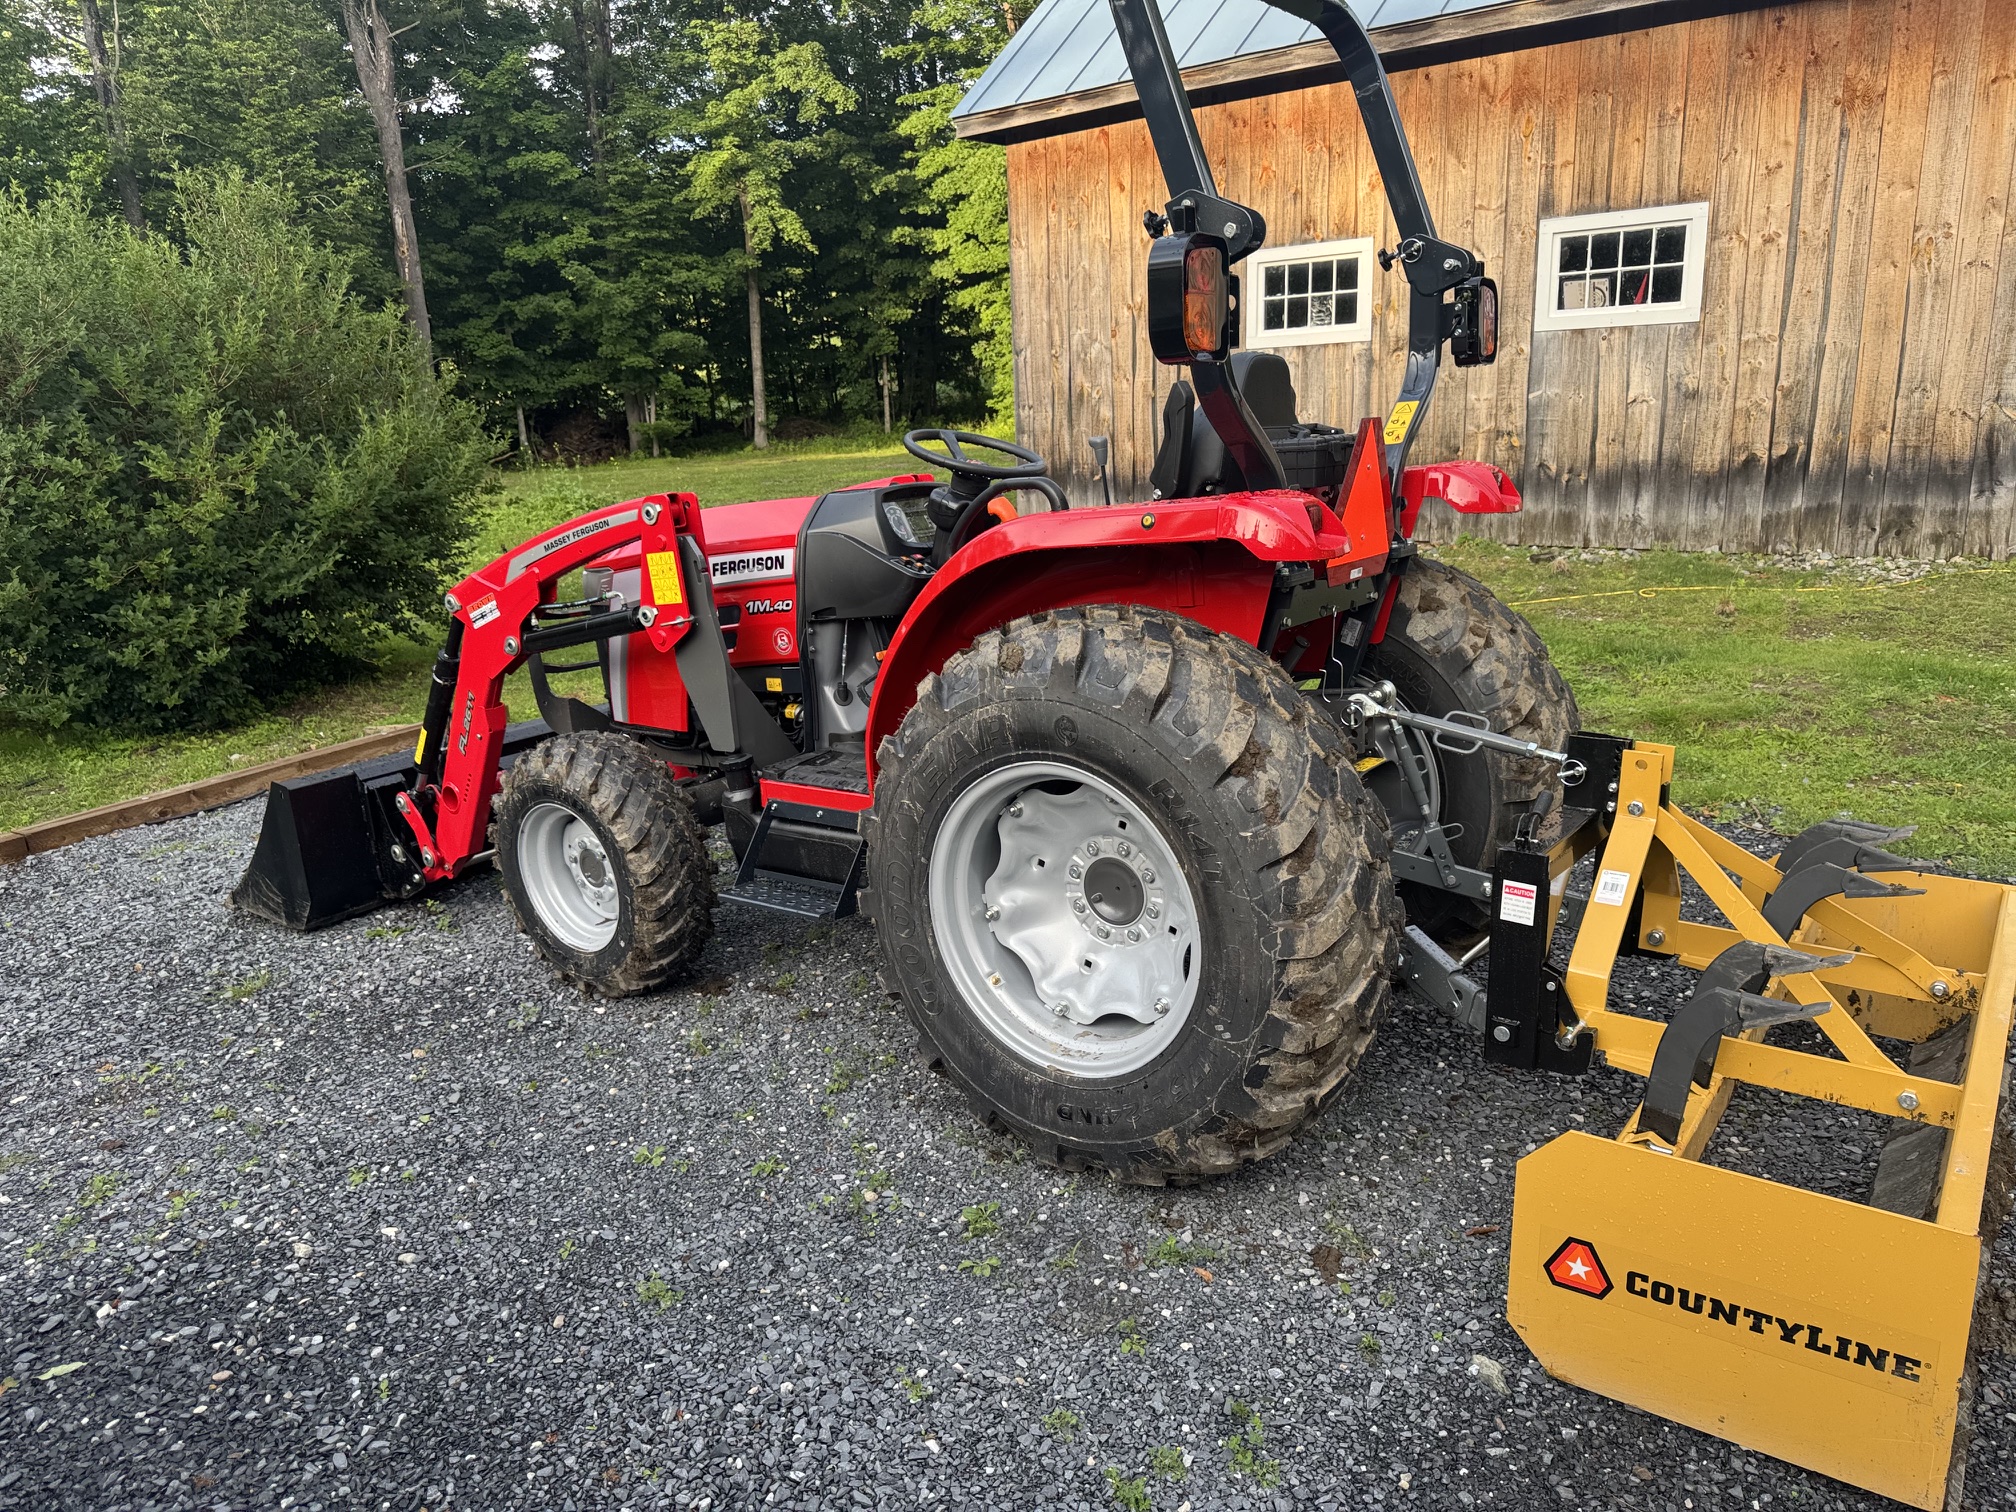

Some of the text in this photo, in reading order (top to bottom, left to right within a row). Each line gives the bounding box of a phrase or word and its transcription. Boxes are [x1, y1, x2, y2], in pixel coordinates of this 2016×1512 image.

[543, 519, 610, 552] MASSEY FERGUSON
[712, 555, 785, 577] FERGUSON
[745, 599, 793, 615] 1M.40
[1510, 888, 1535, 898] CAUTION
